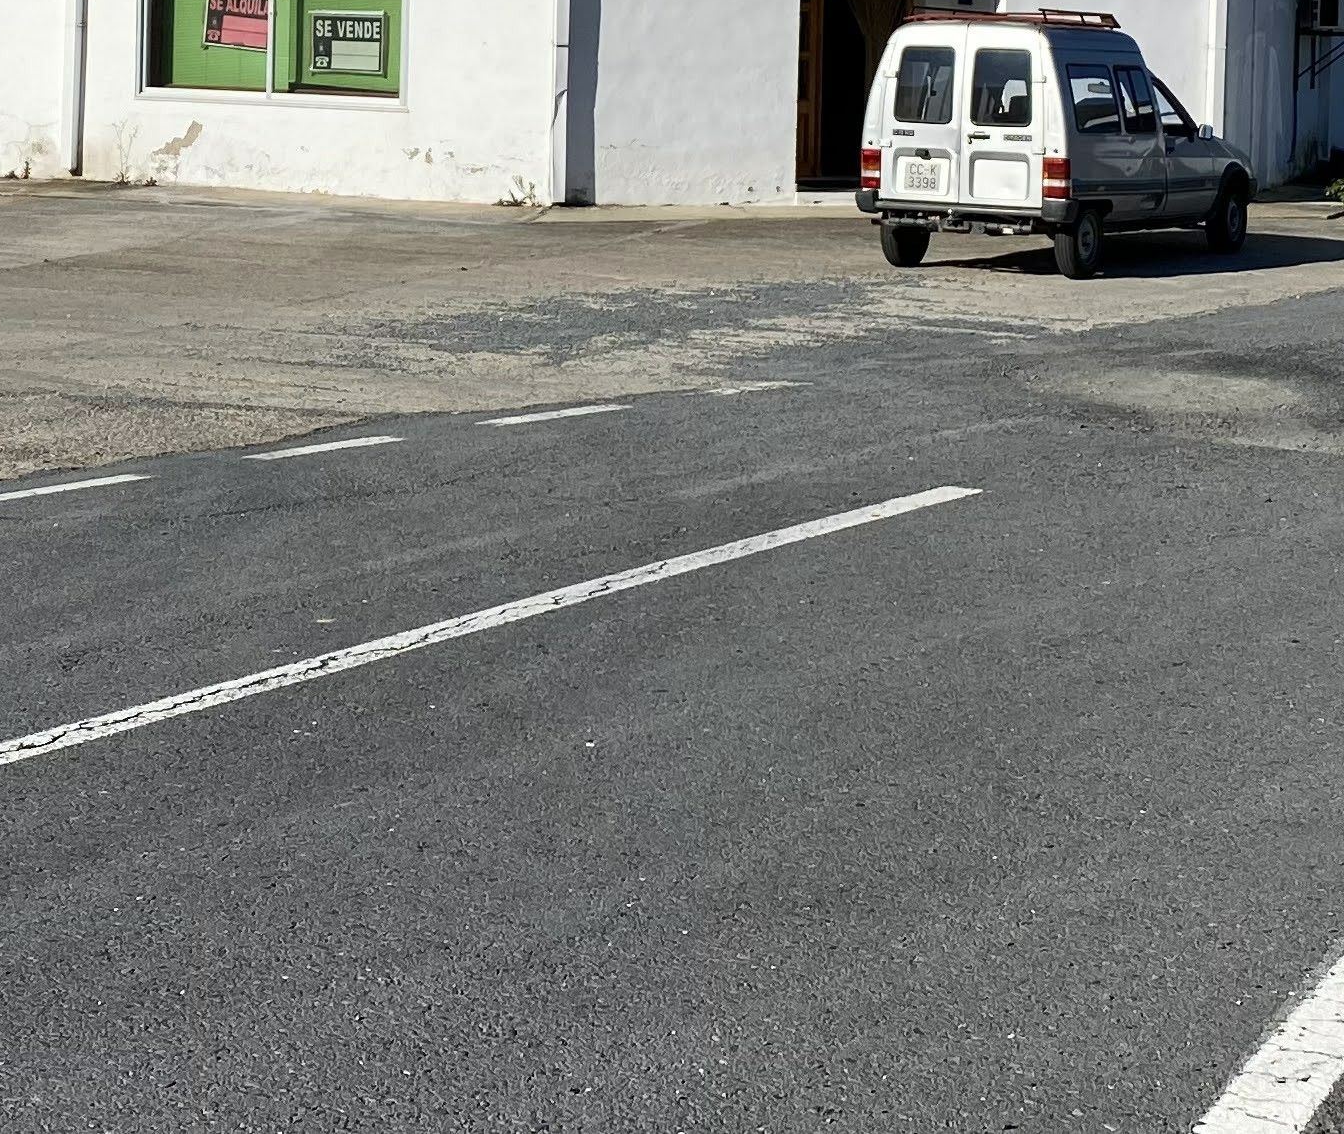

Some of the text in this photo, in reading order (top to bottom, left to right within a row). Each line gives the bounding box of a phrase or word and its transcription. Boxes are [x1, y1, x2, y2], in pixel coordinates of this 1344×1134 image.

[315, 19, 381, 39] SE VENDE
[908, 176, 936, 189] 3398
